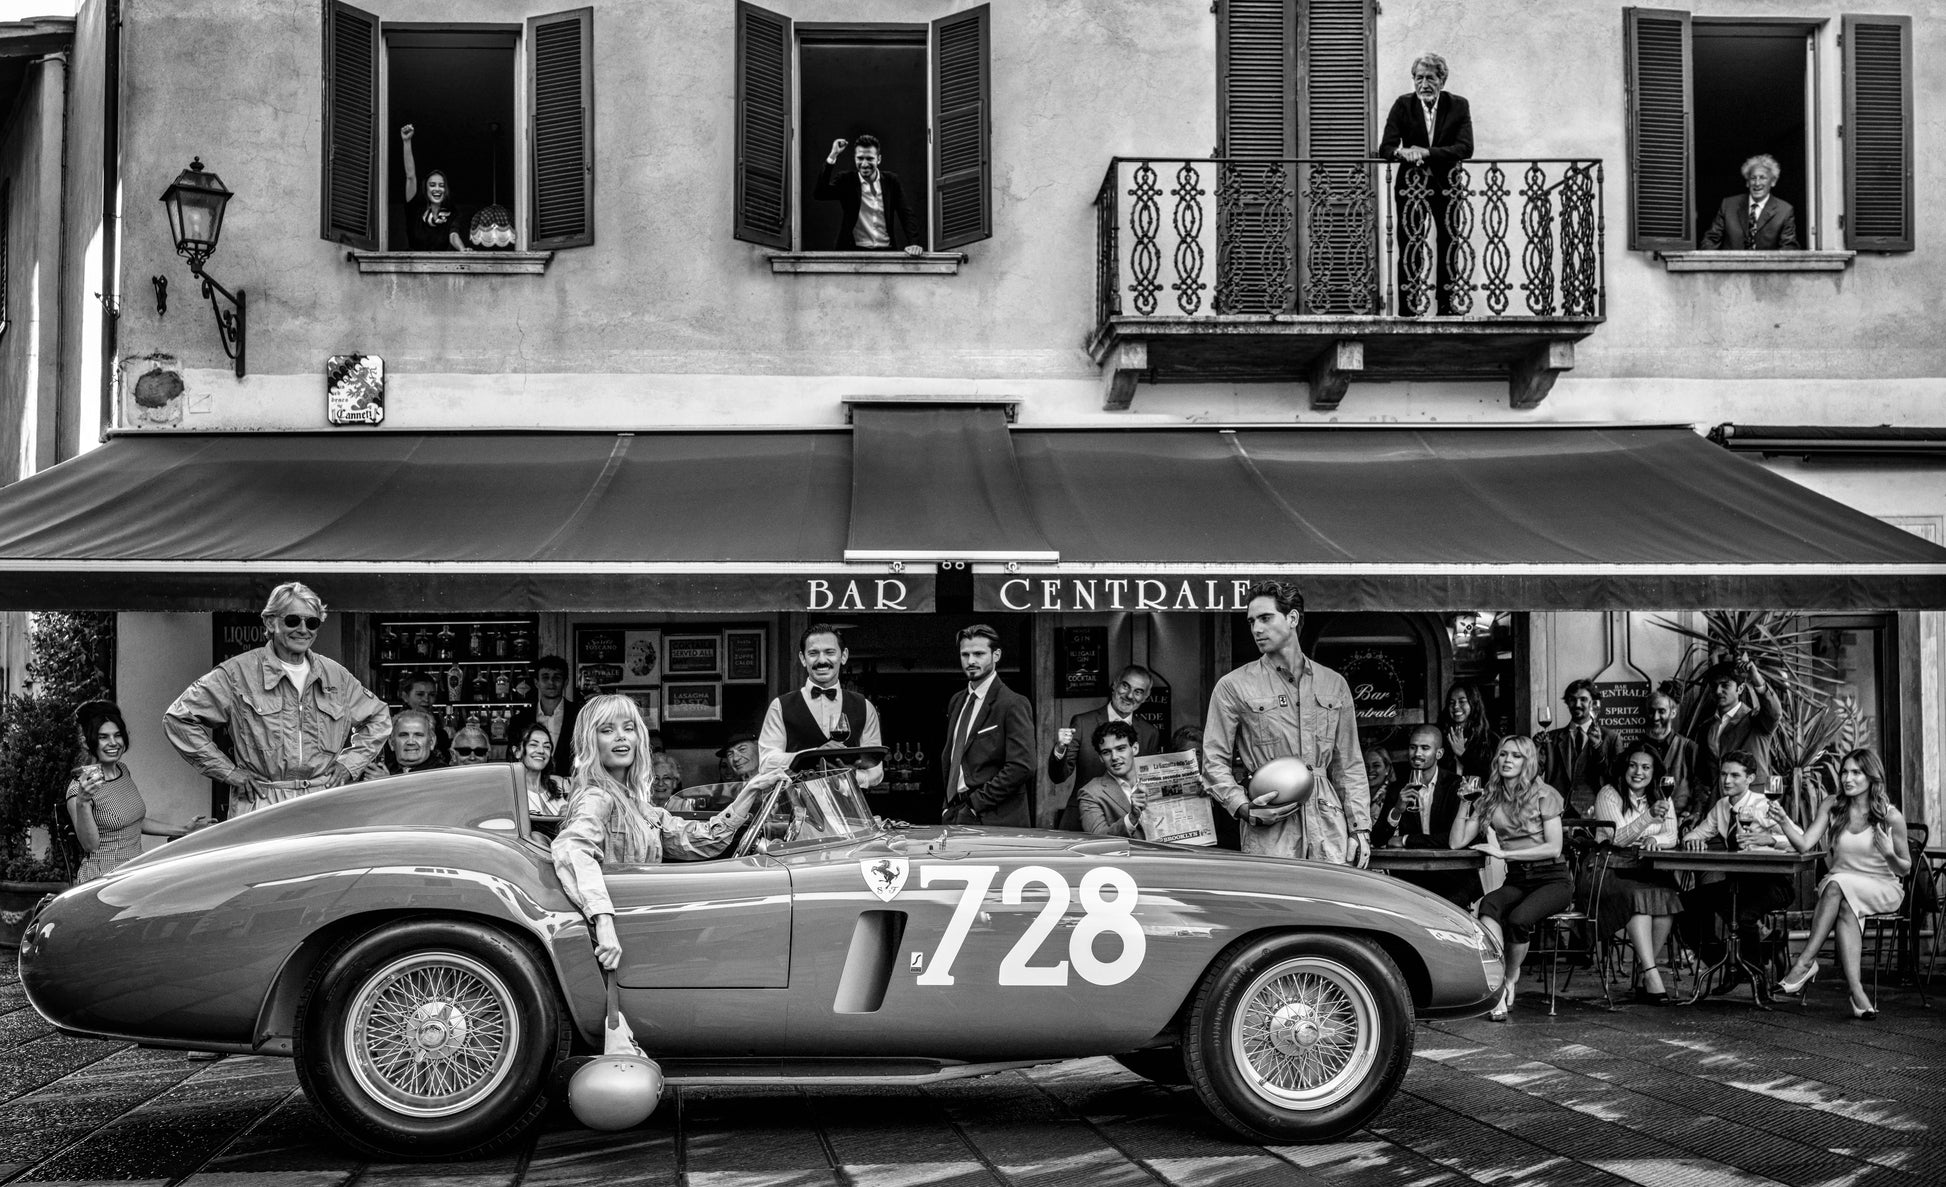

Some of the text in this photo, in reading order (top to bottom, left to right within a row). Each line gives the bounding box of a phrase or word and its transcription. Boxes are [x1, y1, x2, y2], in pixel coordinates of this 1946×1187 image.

[807, 578, 1250, 611] BAR CENTRALE
[672, 649, 712, 657] SERVED ALL
[1354, 683, 1390, 701] Bar
[1600, 689, 1649, 698] ENTRALE
[1355, 704, 1397, 718] ntrale
[1605, 706, 1640, 715] SPRITZ
[1599, 717, 1646, 726] TOSCANO
[917, 865, 1146, 986] 728
